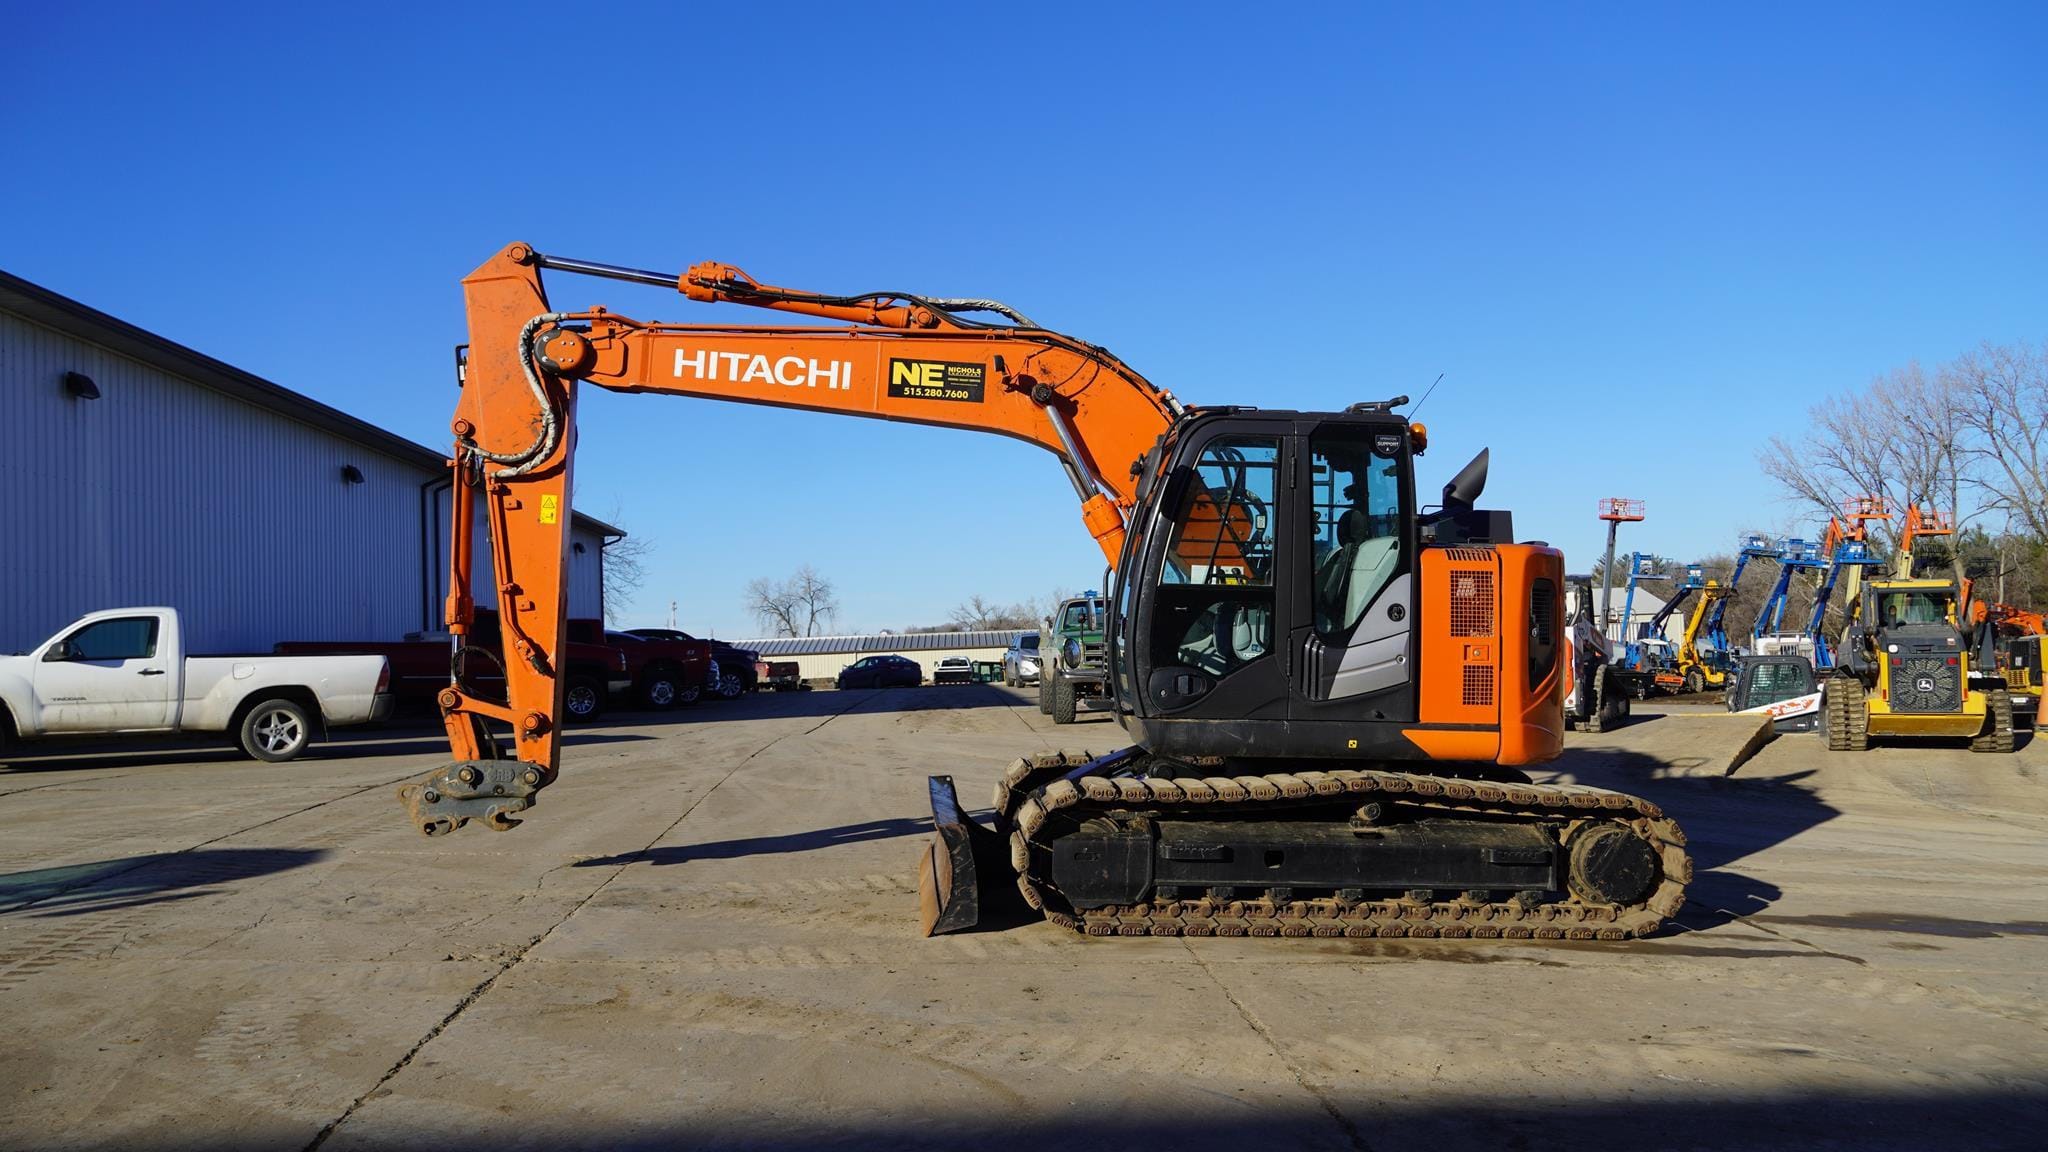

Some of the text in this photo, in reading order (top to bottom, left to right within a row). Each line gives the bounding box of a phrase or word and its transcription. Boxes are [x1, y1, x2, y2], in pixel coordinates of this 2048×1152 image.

[673, 348, 852, 390] HITACHI
[892, 361, 945, 387] NE
[947, 366, 982, 375] NICHOLS
[903, 387, 969, 399] 515.280.7600
